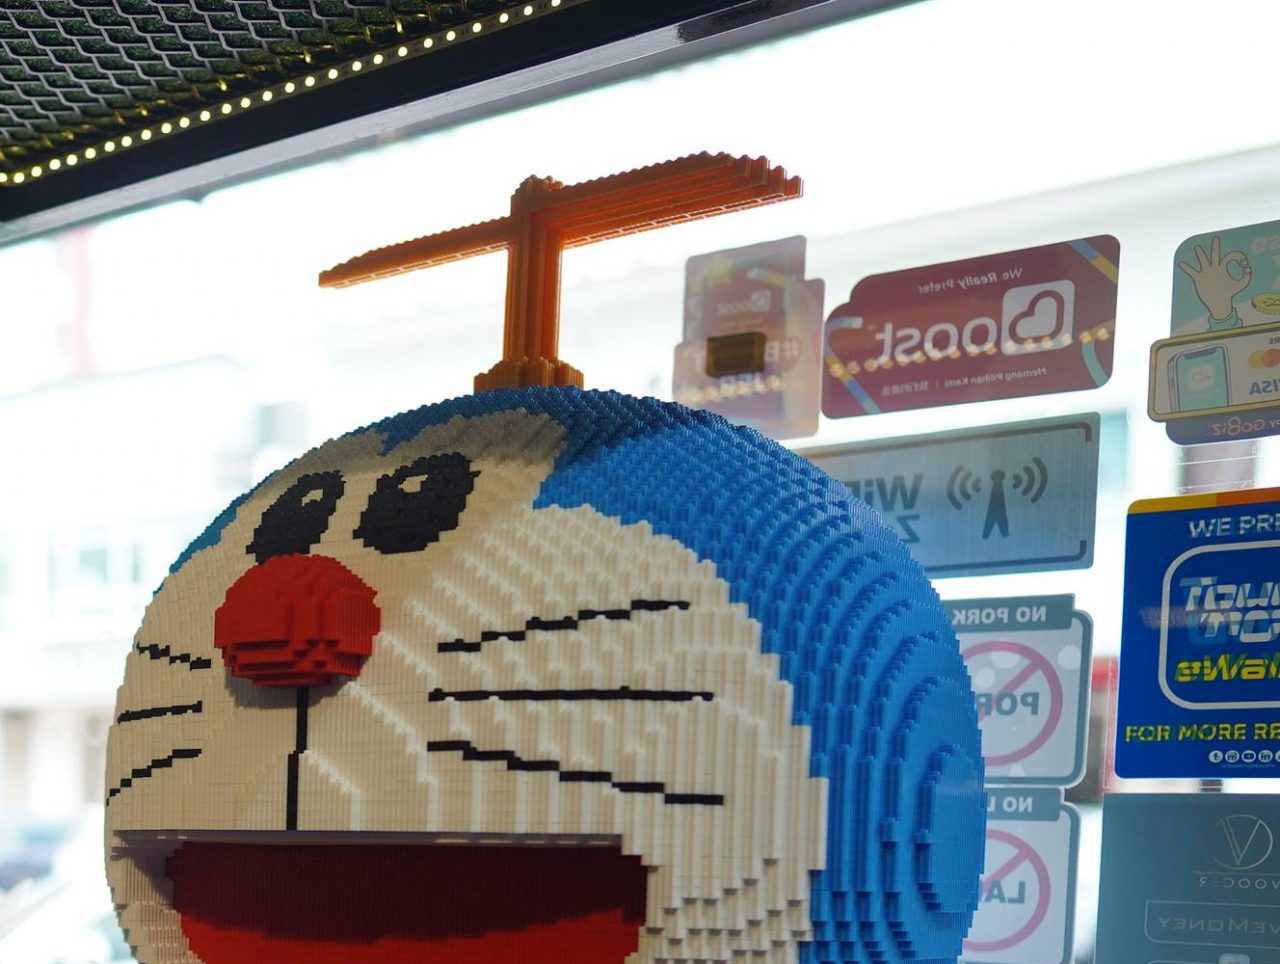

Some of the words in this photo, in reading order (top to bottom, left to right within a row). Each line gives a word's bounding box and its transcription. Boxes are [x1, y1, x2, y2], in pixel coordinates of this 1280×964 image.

[1188, 517, 1233, 539] WE
[1125, 725, 1171, 742] FOR
[1178, 723, 1247, 741] MORE
